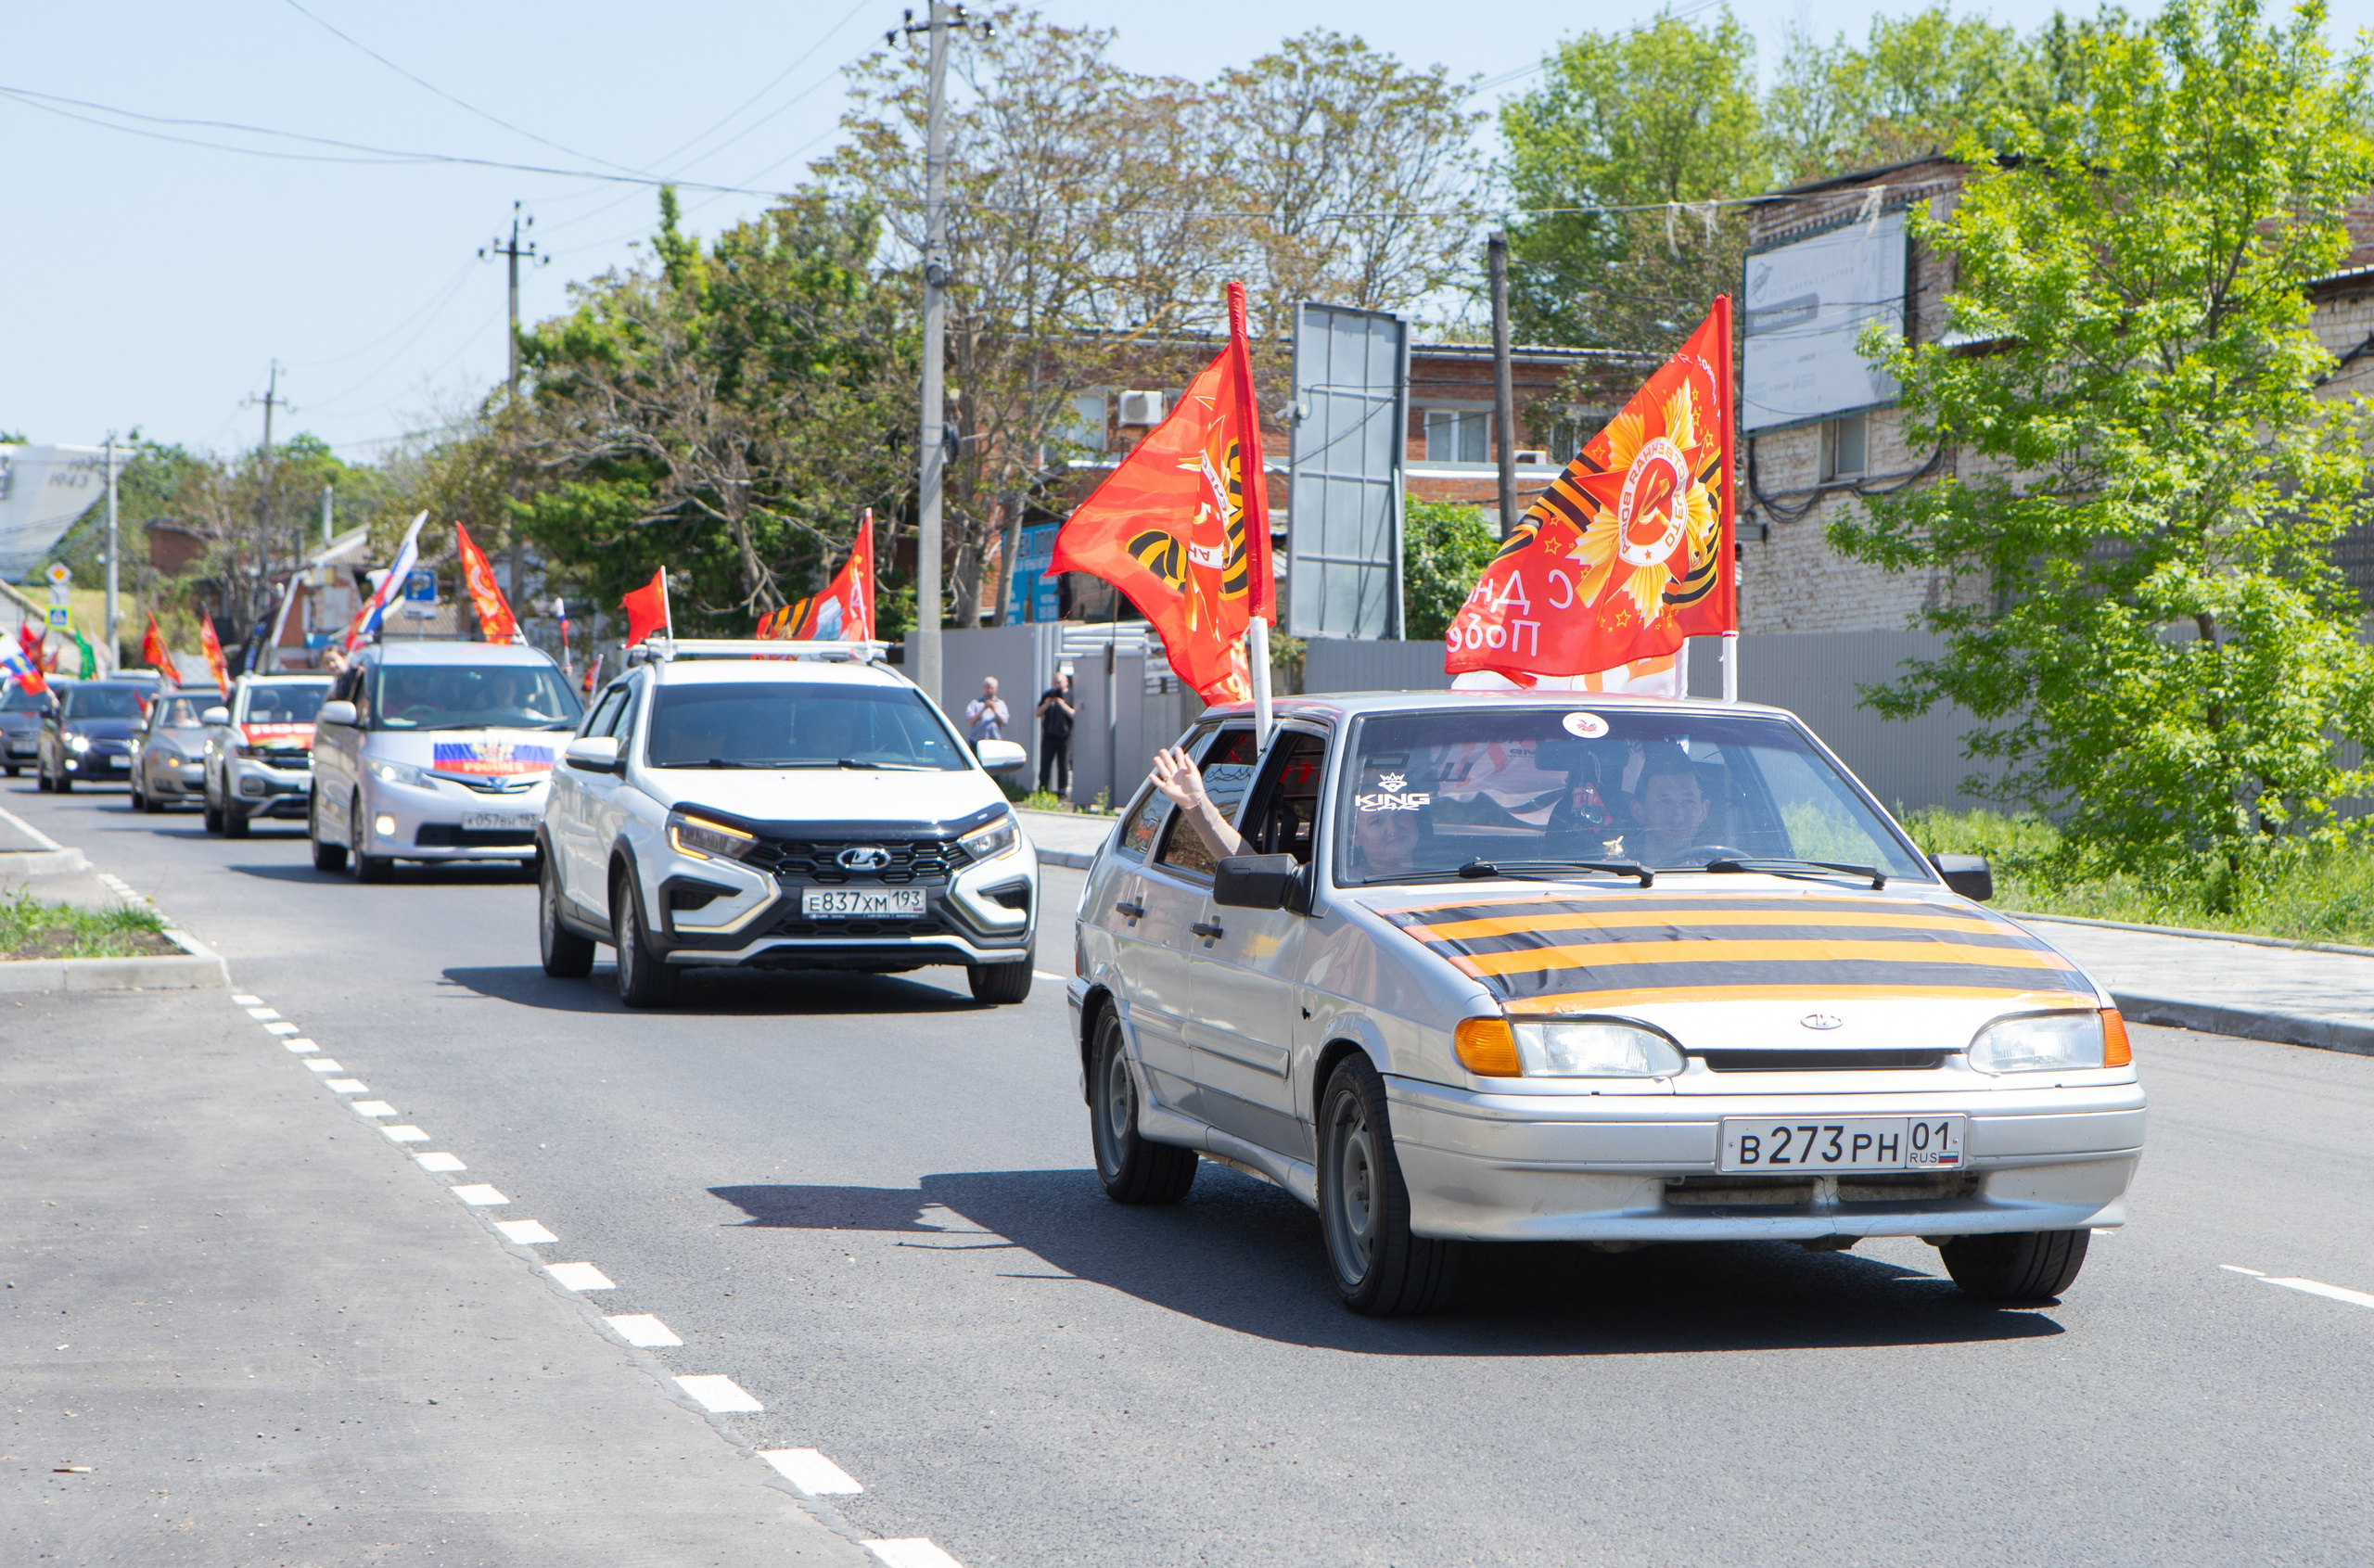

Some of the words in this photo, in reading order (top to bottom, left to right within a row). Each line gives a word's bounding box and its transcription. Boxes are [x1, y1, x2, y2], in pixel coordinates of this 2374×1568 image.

[1354, 793, 1431, 808] KING
[810, 891, 887, 912] Е837ХМ
[891, 890, 921, 906] 193
[1739, 1125, 1899, 1165] В273РН
[1911, 1121, 1950, 1151] 01
[1909, 1152, 1938, 1164] RUS
